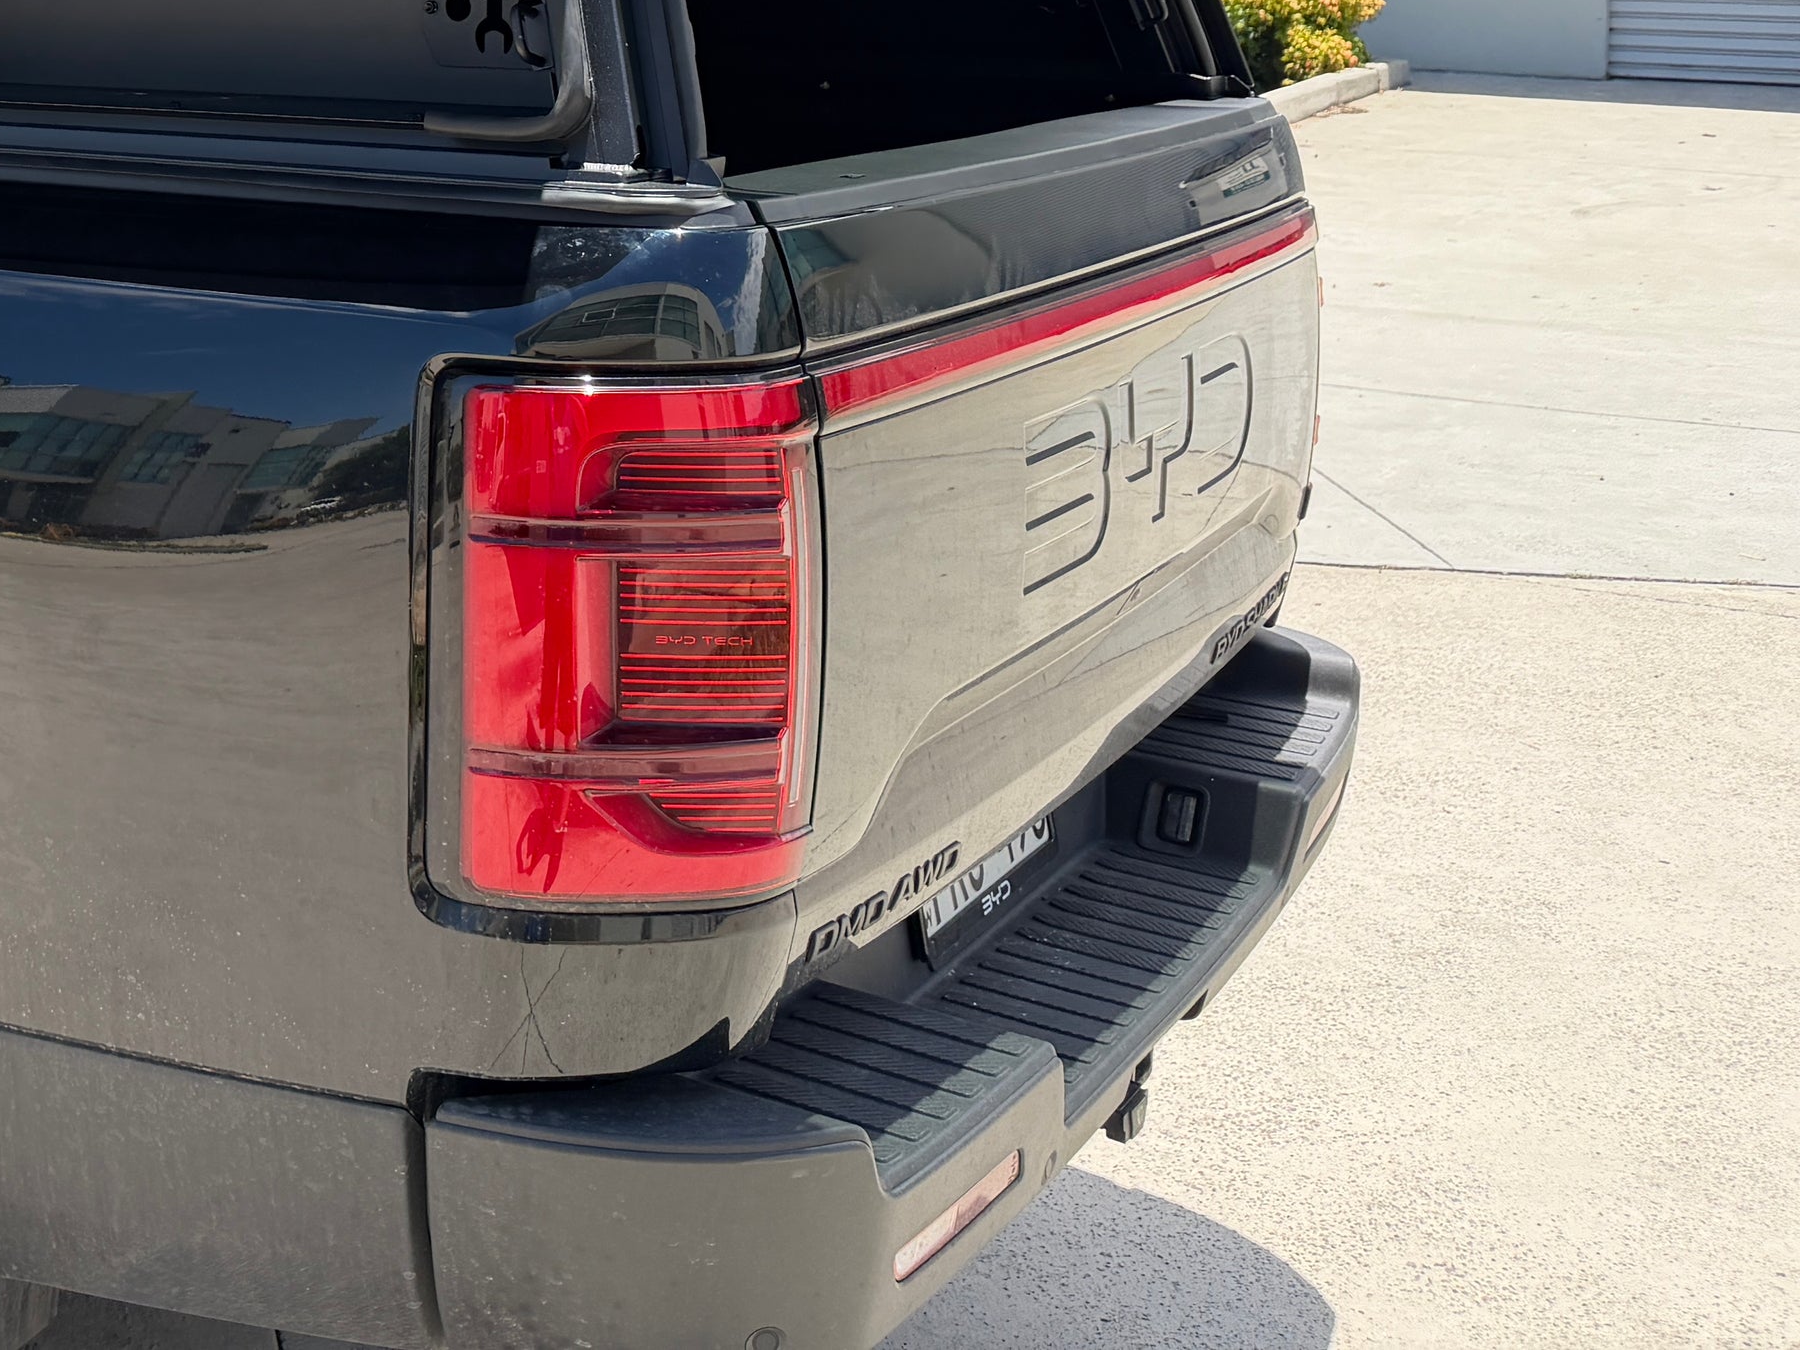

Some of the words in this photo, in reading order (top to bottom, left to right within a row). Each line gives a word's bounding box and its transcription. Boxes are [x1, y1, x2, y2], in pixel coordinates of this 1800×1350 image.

[1022, 330, 1254, 597] BYD
[655, 635, 696, 645] BYD
[702, 635, 753, 646] TECH
[888, 839, 962, 912] AWD
[981, 879, 1012, 916] BYD
